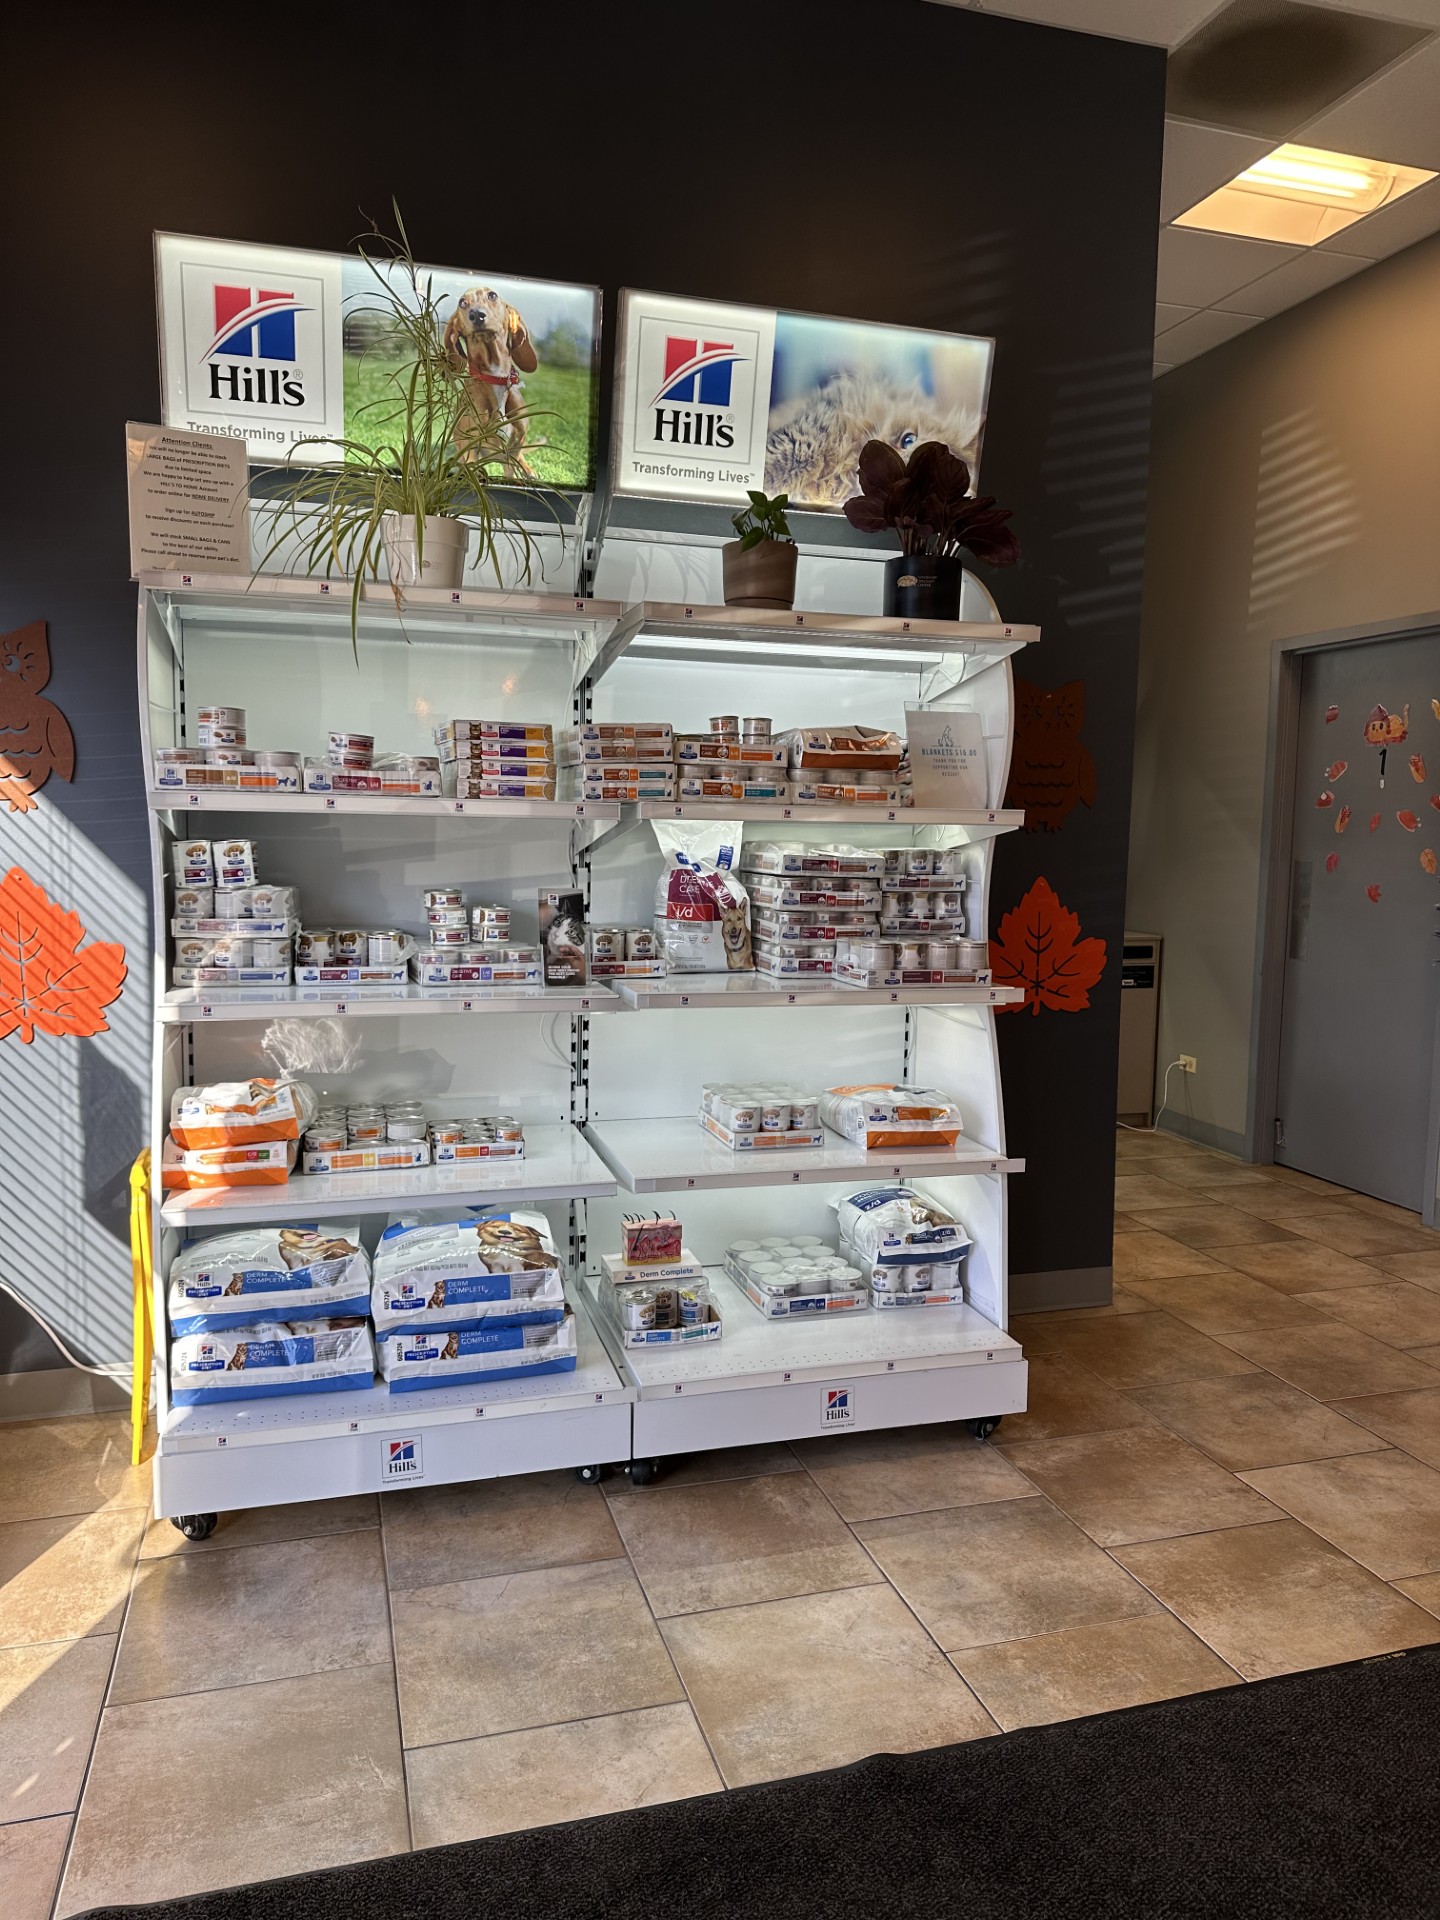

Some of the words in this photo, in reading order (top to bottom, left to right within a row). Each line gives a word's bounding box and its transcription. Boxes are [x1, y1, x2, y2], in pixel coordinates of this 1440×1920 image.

[186, 421, 285, 443] Transforming
[161, 437, 191, 446] Attention
[183, 459, 216, 467] PRESCRIPTION
[632, 461, 714, 482] Transforming
[162, 472, 176, 480] happy
[191, 510, 215, 518] AUTOSHIP
[170, 516, 192, 524] discounts
[922, 748, 953, 756] BLANKETS
[677, 906, 693, 919] i/d
[661, 1268, 693, 1276] Complete
[448, 1280, 468, 1288] DERM
[448, 1286, 485, 1294] COMPLETE
[461, 1335, 499, 1345] COMPLETE
[250, 1349, 289, 1357] COMPLETE
[826, 1409, 850, 1420] Hill's
[389, 1461, 417, 1473] Hill's
